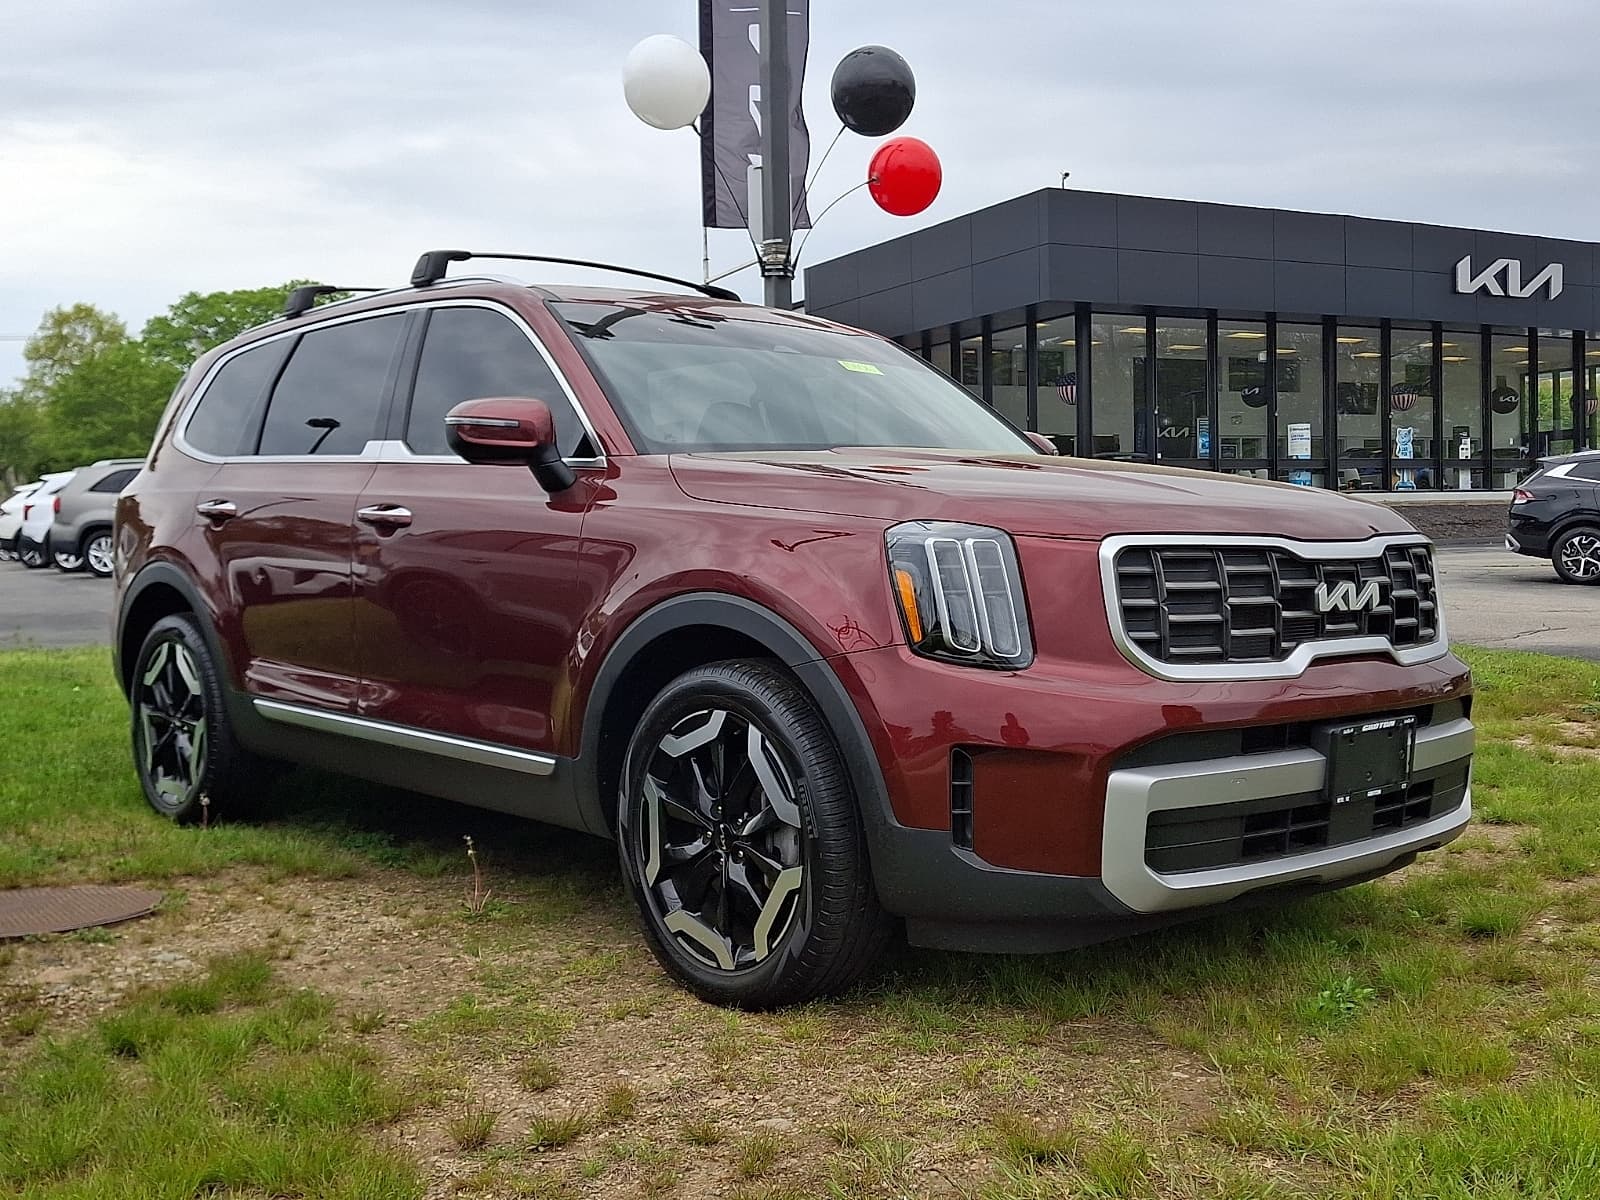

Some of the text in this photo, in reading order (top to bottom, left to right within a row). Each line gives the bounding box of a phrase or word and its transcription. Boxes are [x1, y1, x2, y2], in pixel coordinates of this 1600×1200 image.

[1456, 255, 1563, 300] KIA
[1157, 426, 1190, 438] KIA
[1315, 581, 1380, 612] KIA
